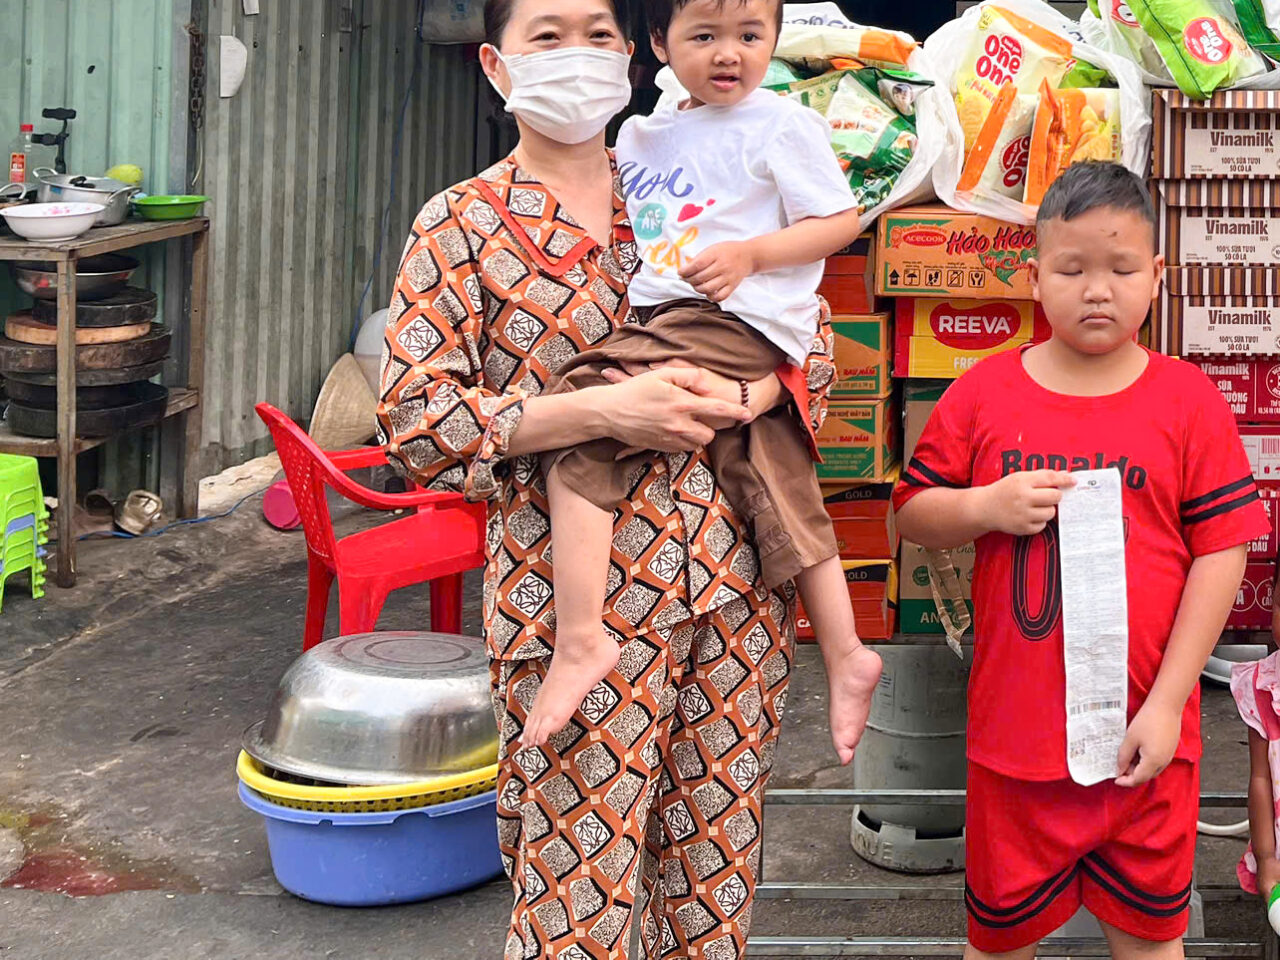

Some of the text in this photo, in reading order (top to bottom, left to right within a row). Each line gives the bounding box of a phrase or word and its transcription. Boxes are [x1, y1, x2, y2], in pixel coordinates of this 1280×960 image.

[1210, 131, 1274, 147] Vinamilk
[1205, 219, 1269, 235] Vinamilk
[946, 226, 990, 255] Hảo
[938, 315, 1011, 334] REEVA
[1208, 310, 1272, 325] Vinamilk
[1000, 449, 1148, 490] Ronaldo
[845, 490, 873, 499] GOLD
[846, 571, 868, 581] OLD
